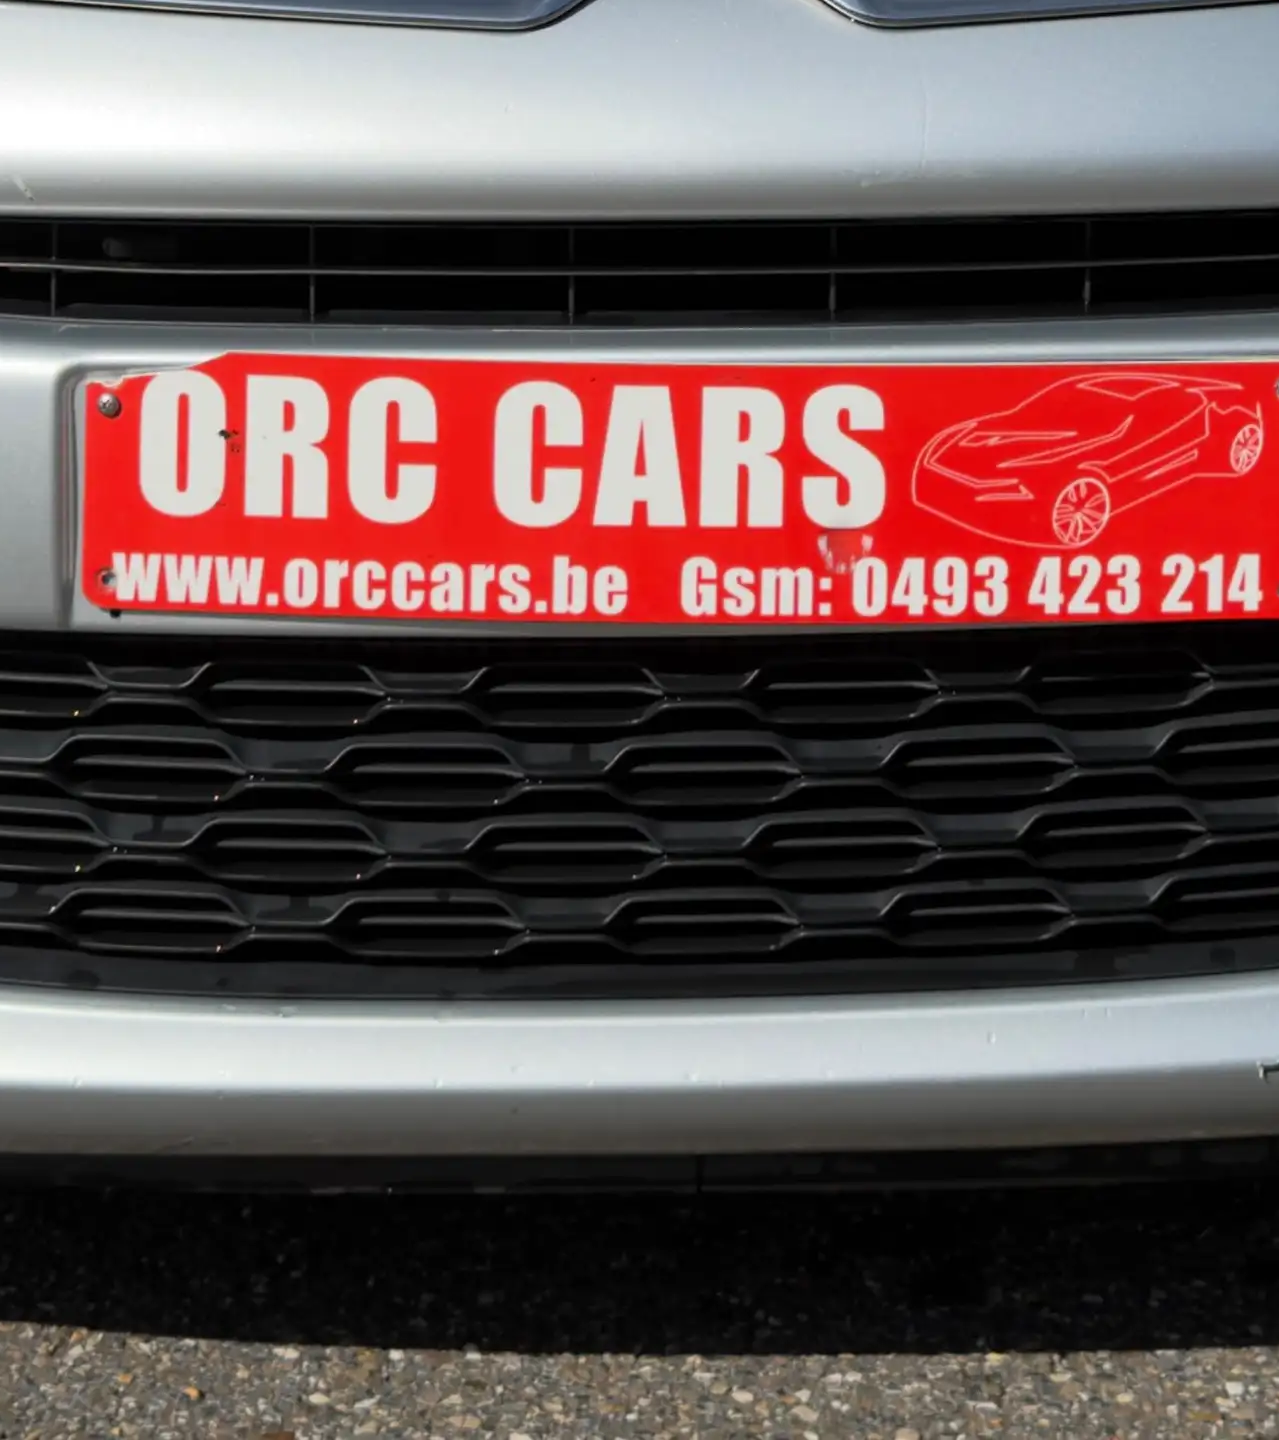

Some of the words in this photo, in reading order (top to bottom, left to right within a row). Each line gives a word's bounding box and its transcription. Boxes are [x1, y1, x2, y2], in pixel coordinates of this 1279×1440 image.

[140, 368, 439, 526] ORC
[492, 379, 887, 530] CARS
[110, 551, 628, 617] www.orccars.be
[680, 555, 832, 618] Gsm:
[849, 554, 1010, 619] 0493
[1027, 553, 1142, 616] 423
[1160, 553, 1264, 614] 214
